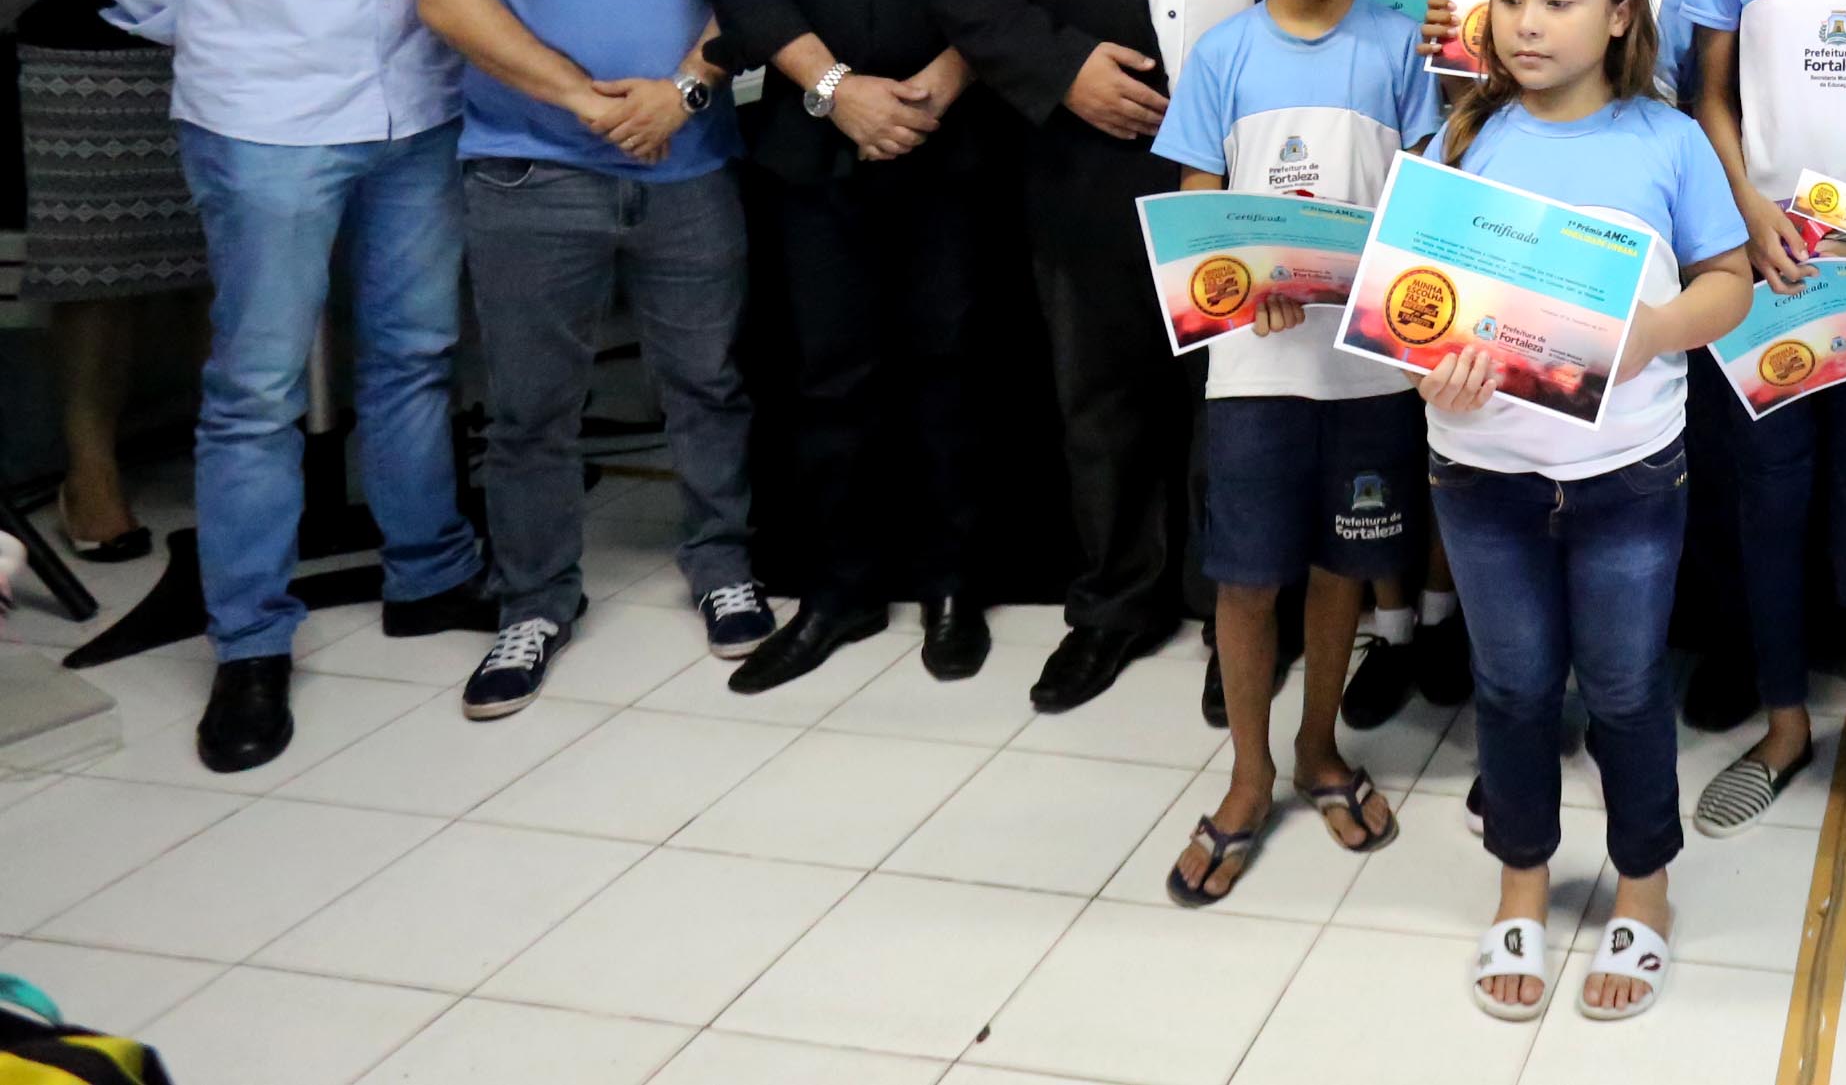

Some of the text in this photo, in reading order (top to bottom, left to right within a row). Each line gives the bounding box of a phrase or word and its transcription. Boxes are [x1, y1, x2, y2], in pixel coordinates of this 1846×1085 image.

[1269, 172, 1319, 185] Fortaleza
[1472, 215, 1540, 245] Certificado
[1603, 230, 1628, 243] AMC
[1407, 285, 1443, 303] ESCOLHA
[1412, 279, 1442, 295] MINHA
[1499, 332, 1544, 353] Fortaleza
[1336, 514, 1387, 527] Prefeitura
[1336, 524, 1402, 540] Fortaleza
